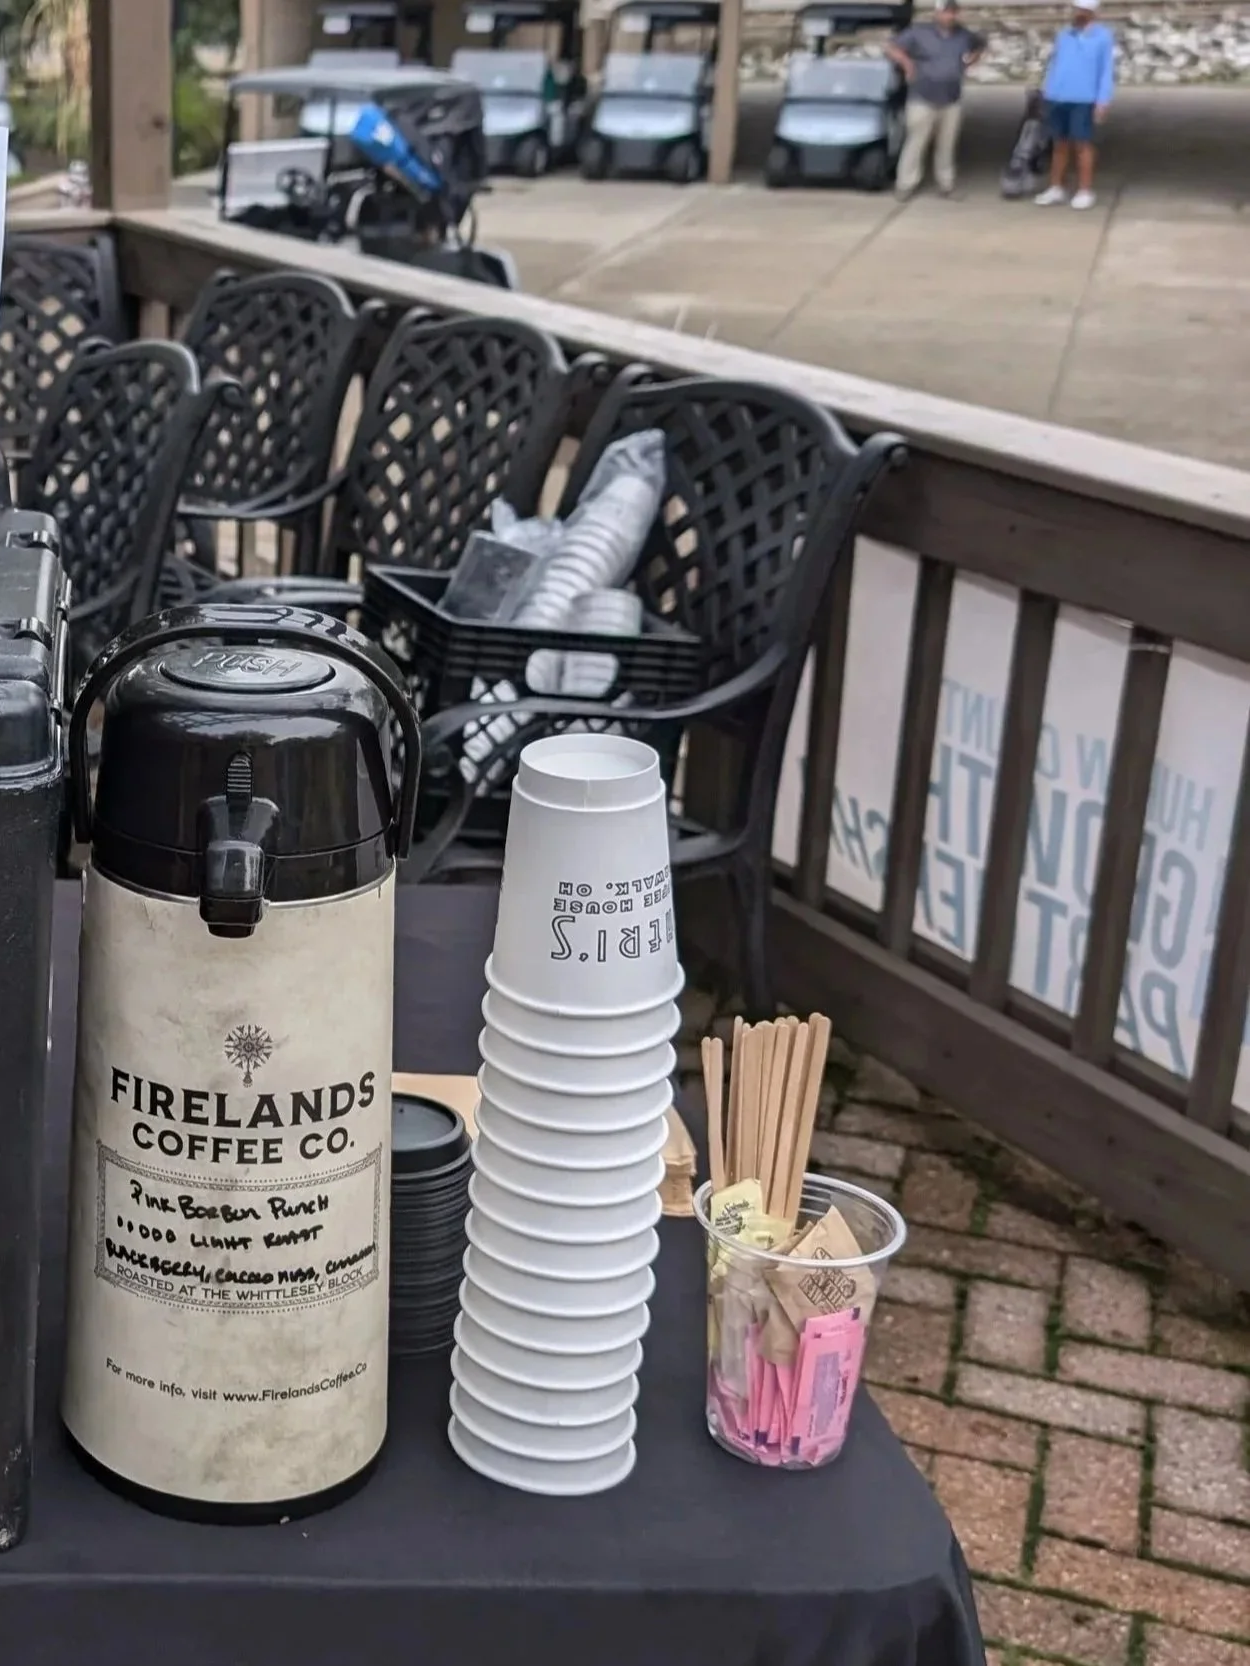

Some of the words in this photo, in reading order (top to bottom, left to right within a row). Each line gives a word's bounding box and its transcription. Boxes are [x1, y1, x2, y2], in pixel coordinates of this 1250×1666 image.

[192, 652, 302, 677] PUSH
[553, 898, 633, 914] HOUSE
[559, 881, 592, 897] OH
[110, 1066, 375, 1129] FIRELANDS
[132, 1122, 283, 1165] COFFEE
[299, 1126, 355, 1160] CO.
[117, 1263, 174, 1292] ROASTED
[179, 1285, 196, 1296] AT
[202, 1288, 231, 1300] THE
[236, 1281, 324, 1300] WHITTLESEY
[328, 1265, 363, 1289] BLOCK
[106, 1357, 122, 1376] For
[126, 1370, 155, 1389] more
[159, 1380, 186, 1398] info,
[191, 1389, 217, 1401] visit
